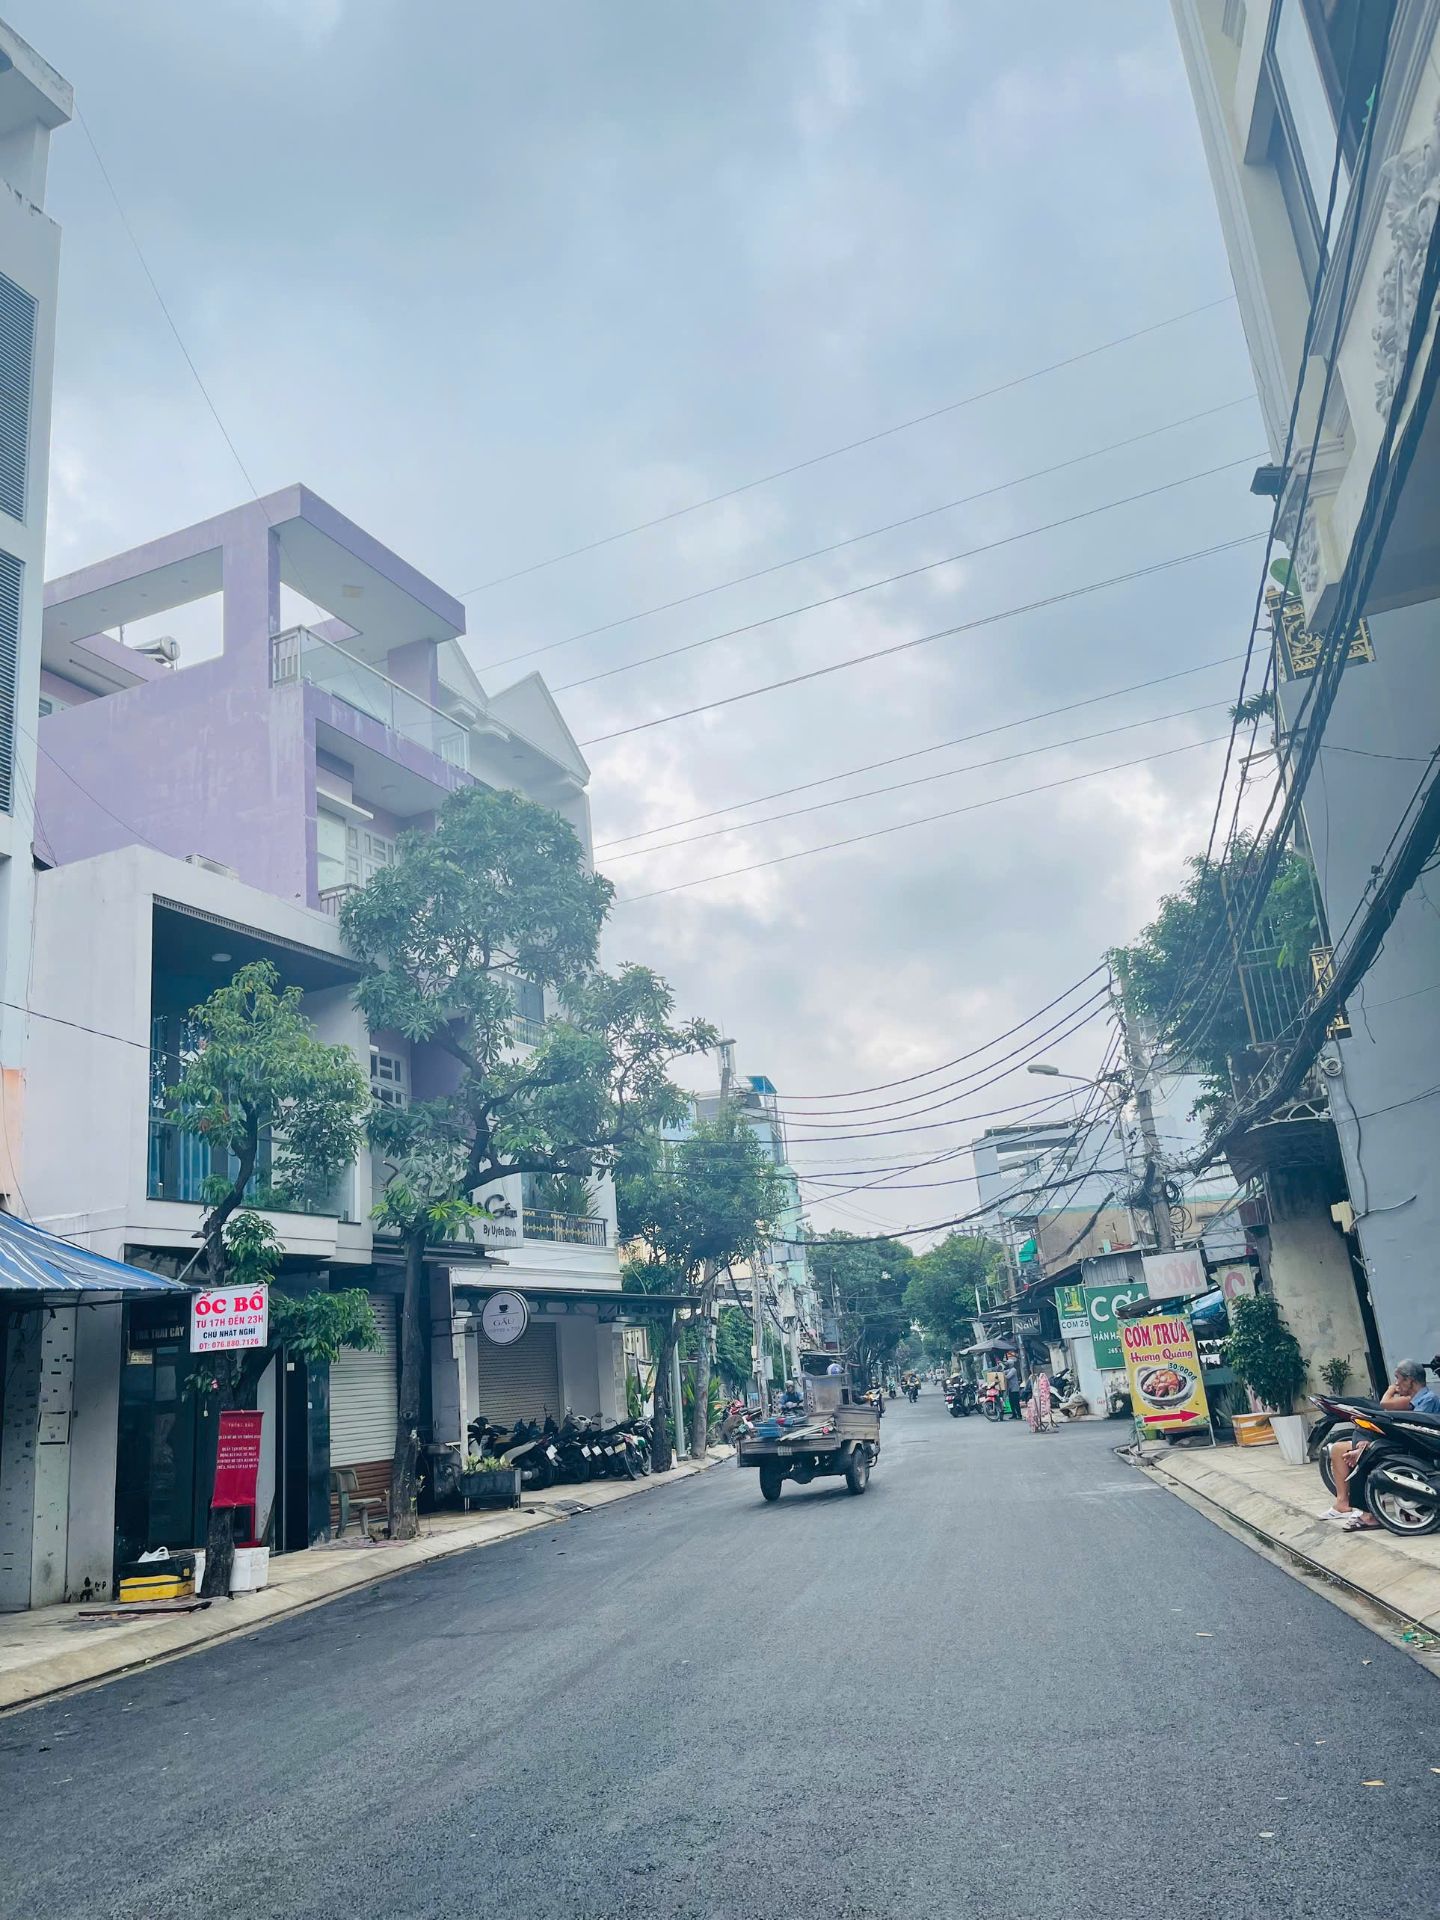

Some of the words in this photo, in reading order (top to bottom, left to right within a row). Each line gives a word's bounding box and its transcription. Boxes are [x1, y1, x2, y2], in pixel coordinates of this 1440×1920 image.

[483, 1224, 490, 1237] By
[195, 1290, 227, 1316] ỐC
[210, 1318, 226, 1327] 17H
[247, 1315, 264, 1324] 23H
[1124, 1321, 1152, 1348] CƠM
[1153, 1318, 1190, 1345] TRƯA
